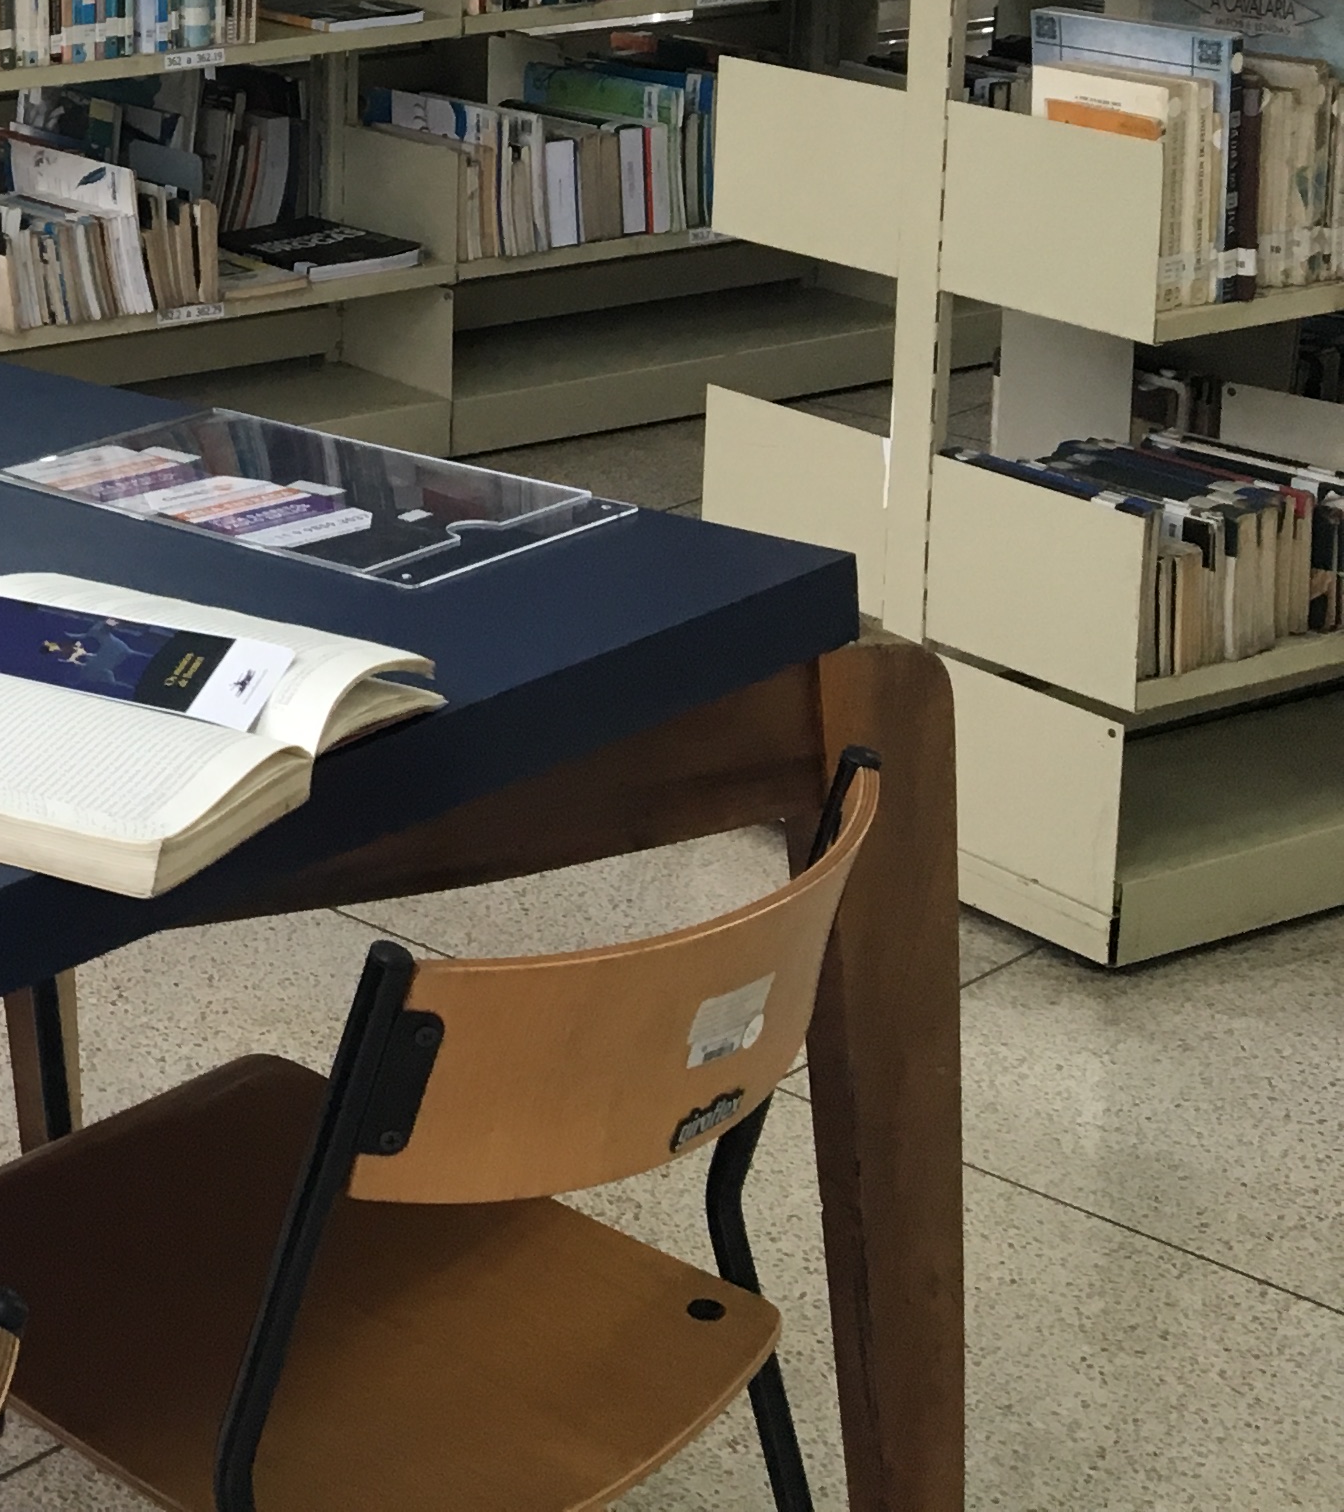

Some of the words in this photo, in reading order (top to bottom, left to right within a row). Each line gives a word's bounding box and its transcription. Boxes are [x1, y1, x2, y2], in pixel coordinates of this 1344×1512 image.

[167, 56, 182, 67] 362
[196, 51, 223, 64] 362.19
[674, 1092, 743, 1151] giroflex
